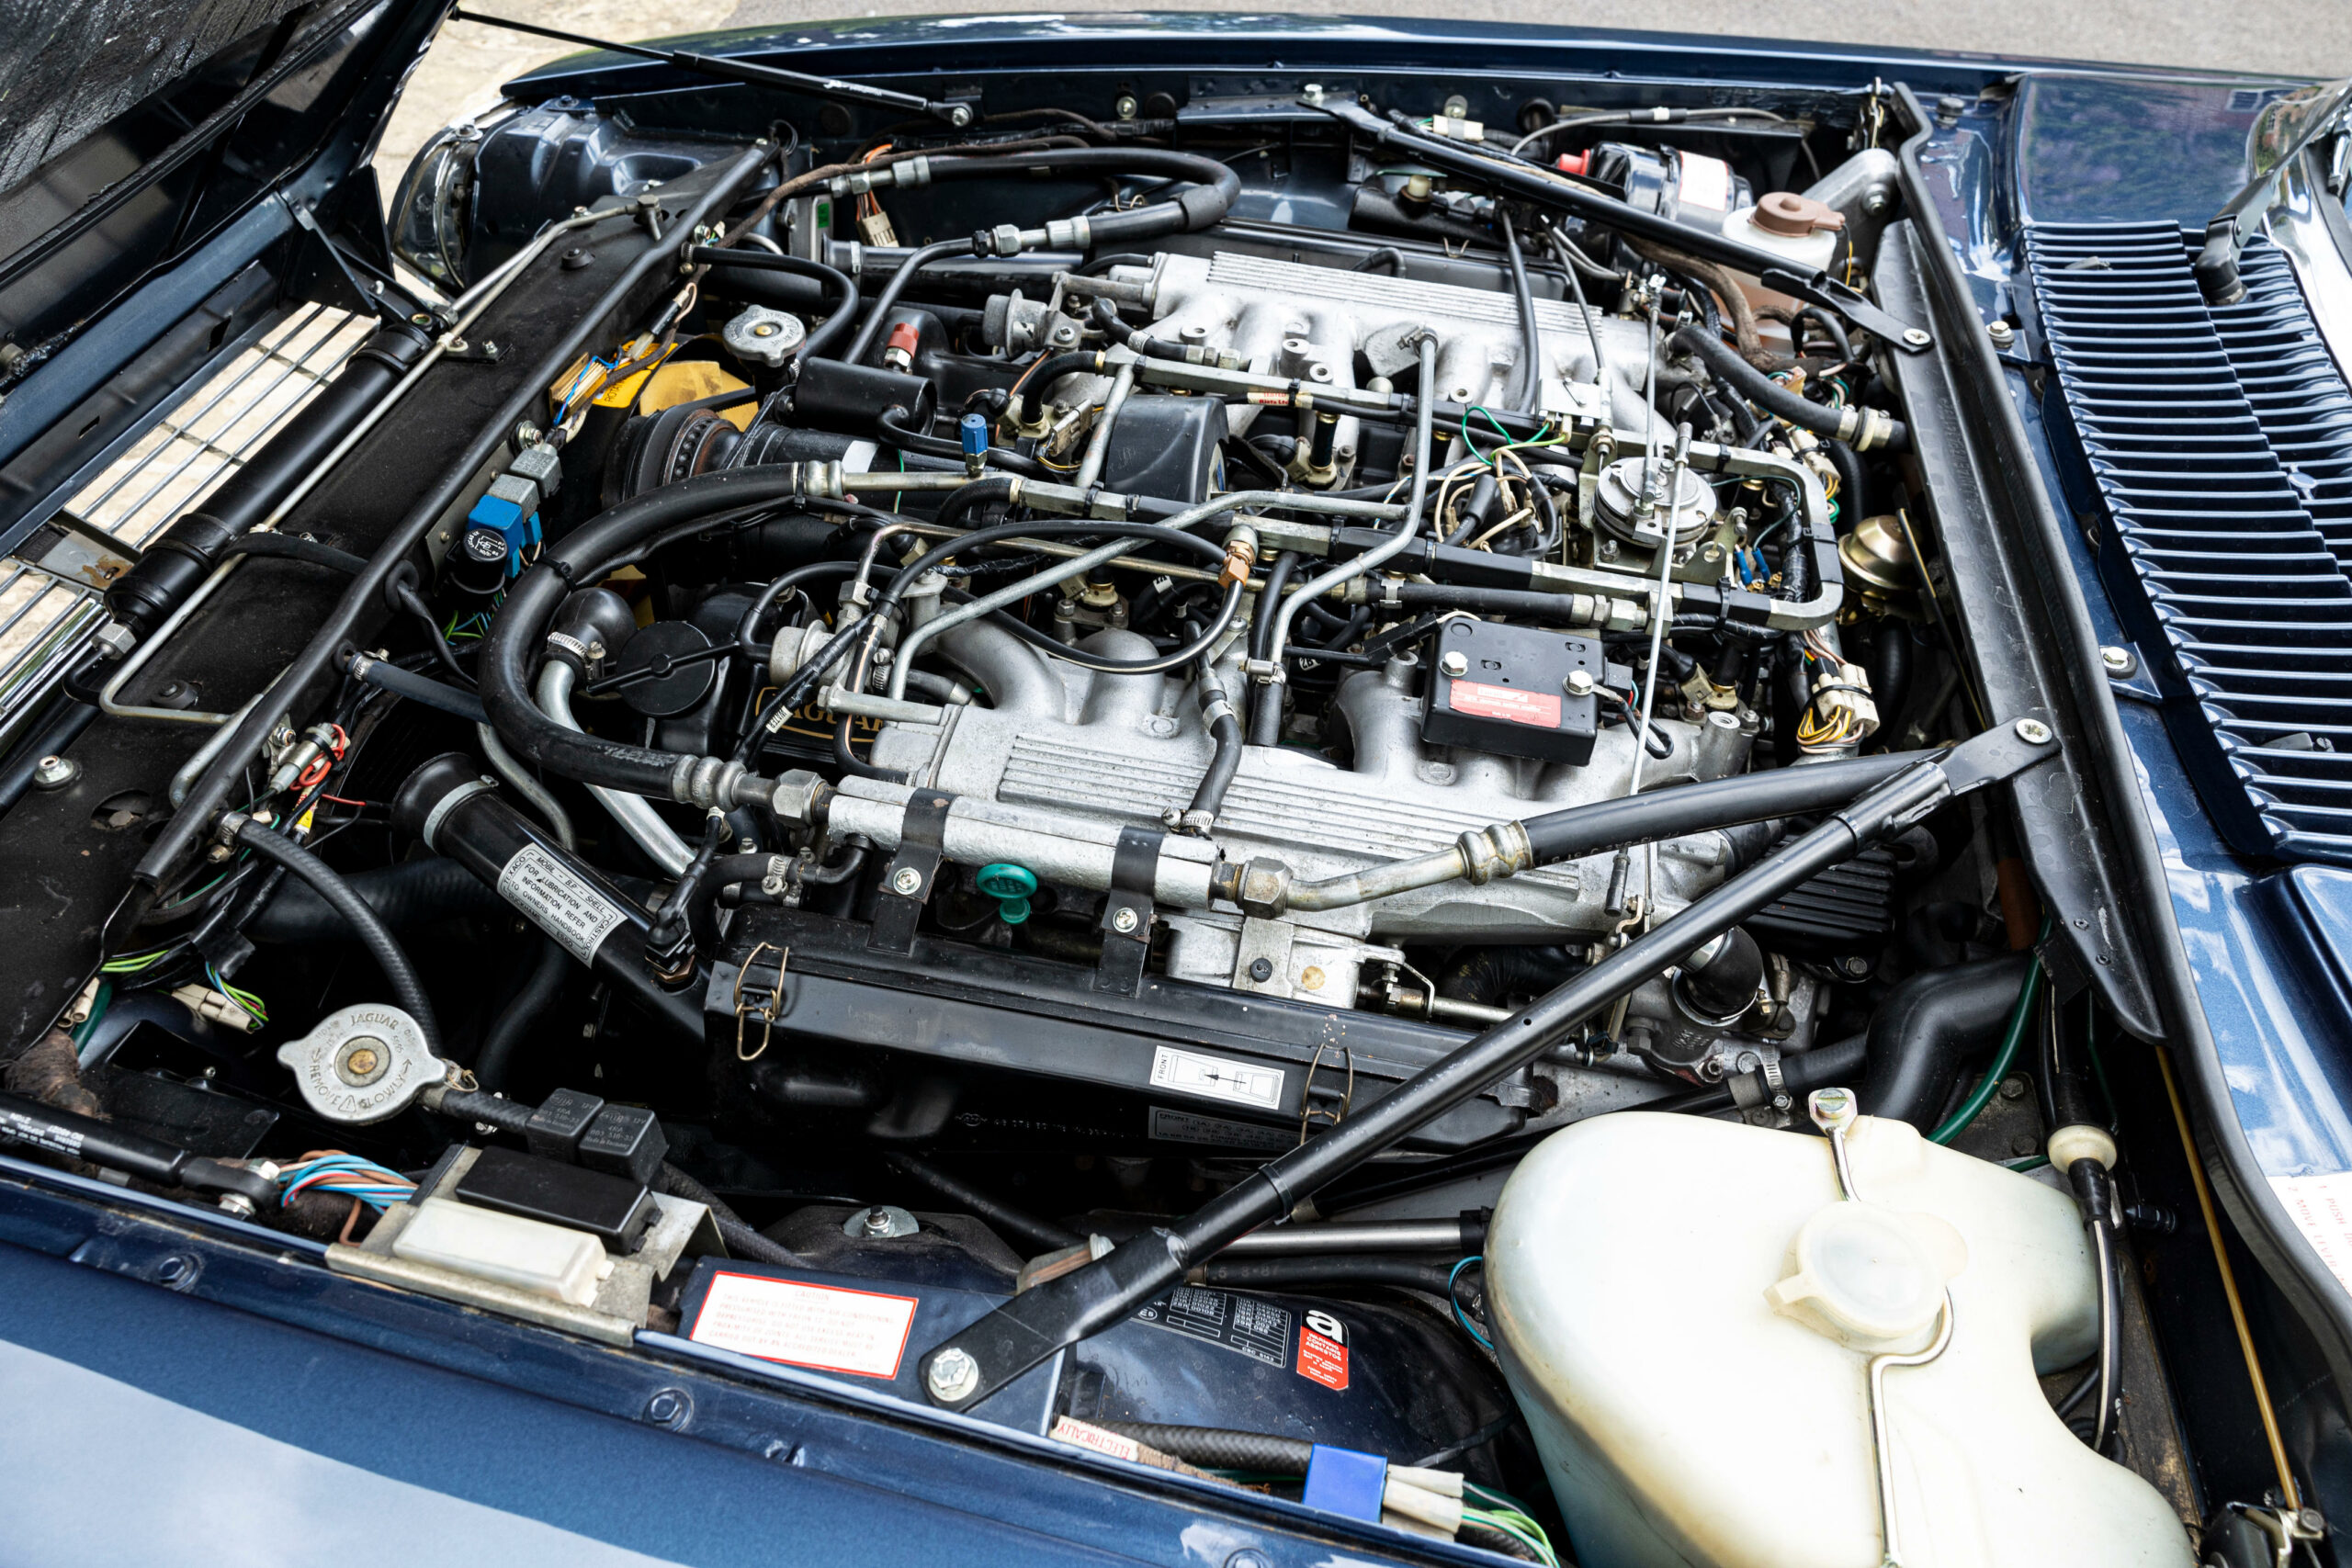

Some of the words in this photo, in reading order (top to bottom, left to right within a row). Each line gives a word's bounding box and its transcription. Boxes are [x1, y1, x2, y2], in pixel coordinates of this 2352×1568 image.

[771, 709, 787, 728] WATER
[503, 856, 526, 884] TEXACO
[537, 856, 555, 874] MOBIL
[585, 896, 605, 913] SHELL
[522, 876, 562, 910] INFORMATION
[565, 910, 586, 930] REFER
[525, 863, 539, 877] FOR
[541, 876, 582, 910] LUBRICATION
[583, 910, 598, 924] AND
[508, 893, 540, 922] DUCKHAMS
[557, 931, 573, 948] ESSO
[511, 881, 519, 891] TO
[523, 891, 549, 915] OWNERS
[551, 914, 584, 943] HANDBOOK
[584, 919, 609, 952] CASTROL
[351, 1012, 399, 1031] JAGUAR
[1157, 1054, 1168, 1079] FRONT
[310, 1065, 341, 1105] REMOVE
[1305, 1339, 1341, 1361] ASBESTOS
[1306, 1335, 1340, 1356] CONTAINS
[1308, 1331, 1339, 1350] WARNING
[1057, 1423, 1130, 1458] ELECTRICALLY
